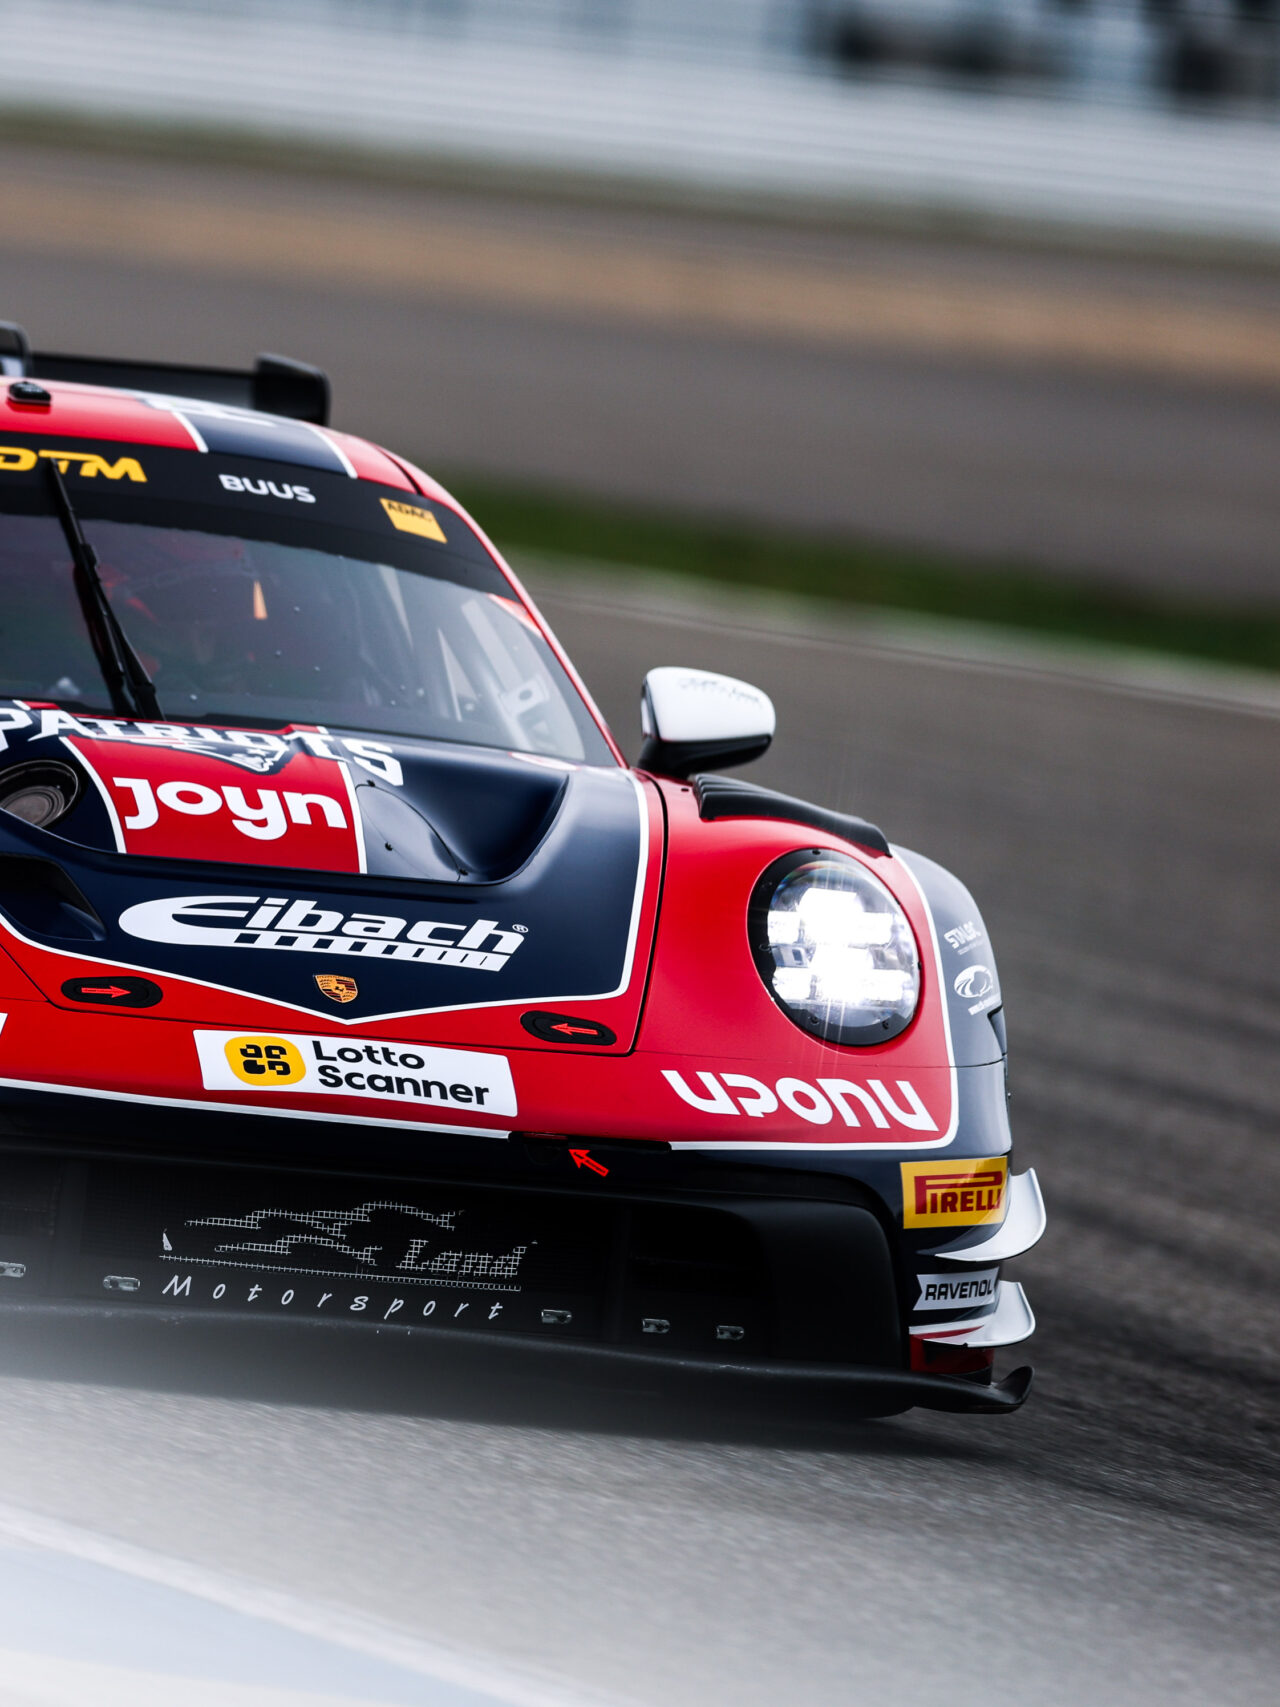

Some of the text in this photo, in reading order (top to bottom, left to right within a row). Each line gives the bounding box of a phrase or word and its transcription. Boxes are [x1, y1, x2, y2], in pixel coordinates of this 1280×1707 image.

[220, 473, 316, 503] BUUS
[312, 1040, 426, 1070] Lotto
[317, 1064, 490, 1106] Scanner
[914, 1171, 1003, 1215] PIRELLI
[396, 1238, 528, 1279] Land
[162, 1275, 504, 1319] Motorsport
[925, 1279, 993, 1301] RAVENOL
